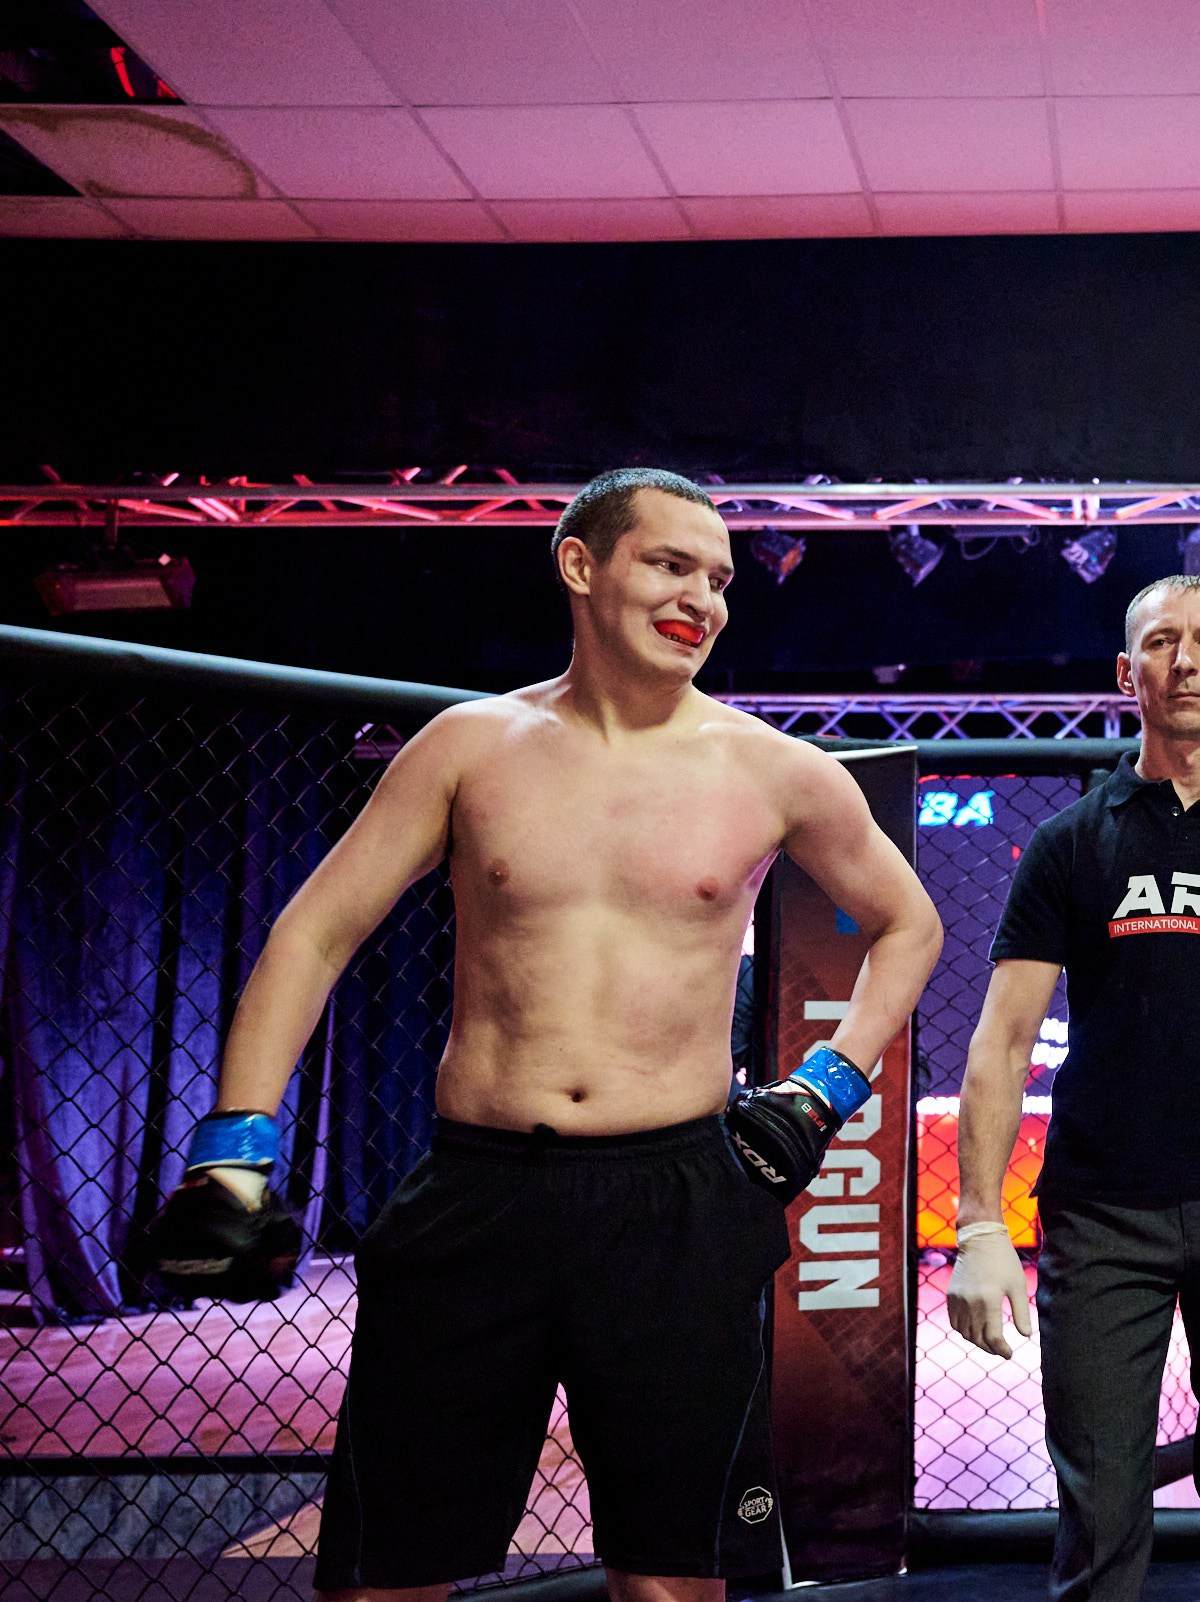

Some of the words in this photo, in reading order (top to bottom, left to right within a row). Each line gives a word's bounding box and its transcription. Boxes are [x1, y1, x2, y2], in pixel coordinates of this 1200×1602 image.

[1113, 919, 1198, 934] INTERNATIONAL
[730, 1130, 788, 1184] RDX
[744, 1496, 765, 1508] SPORT
[745, 1504, 767, 1518] GEAR
